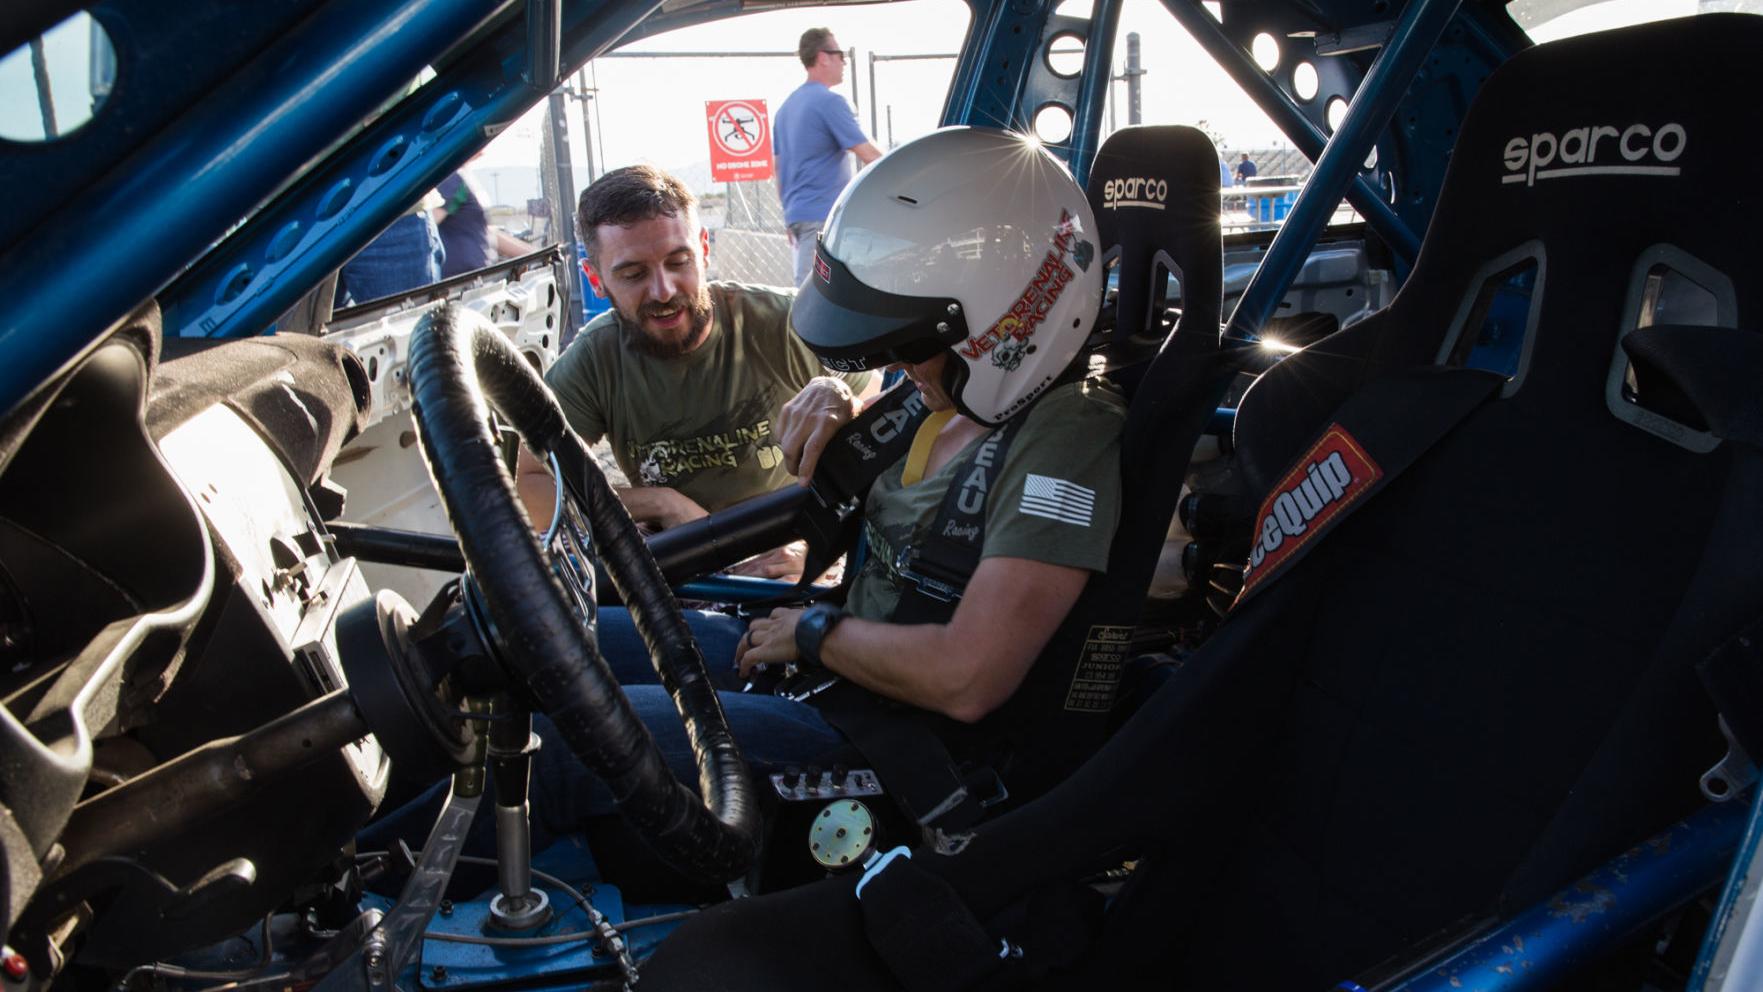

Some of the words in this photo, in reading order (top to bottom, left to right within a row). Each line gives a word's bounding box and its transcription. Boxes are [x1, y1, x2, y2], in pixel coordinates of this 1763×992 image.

[1503, 122, 1687, 187] sparco
[1104, 177, 1167, 211] sparco
[1014, 261, 1076, 342] RACING
[994, 374, 1054, 421] ProSport
[661, 450, 738, 477] RACING
[848, 432, 877, 461] Racing
[1249, 451, 1352, 568] ceQuip
[942, 519, 980, 542] Racing
